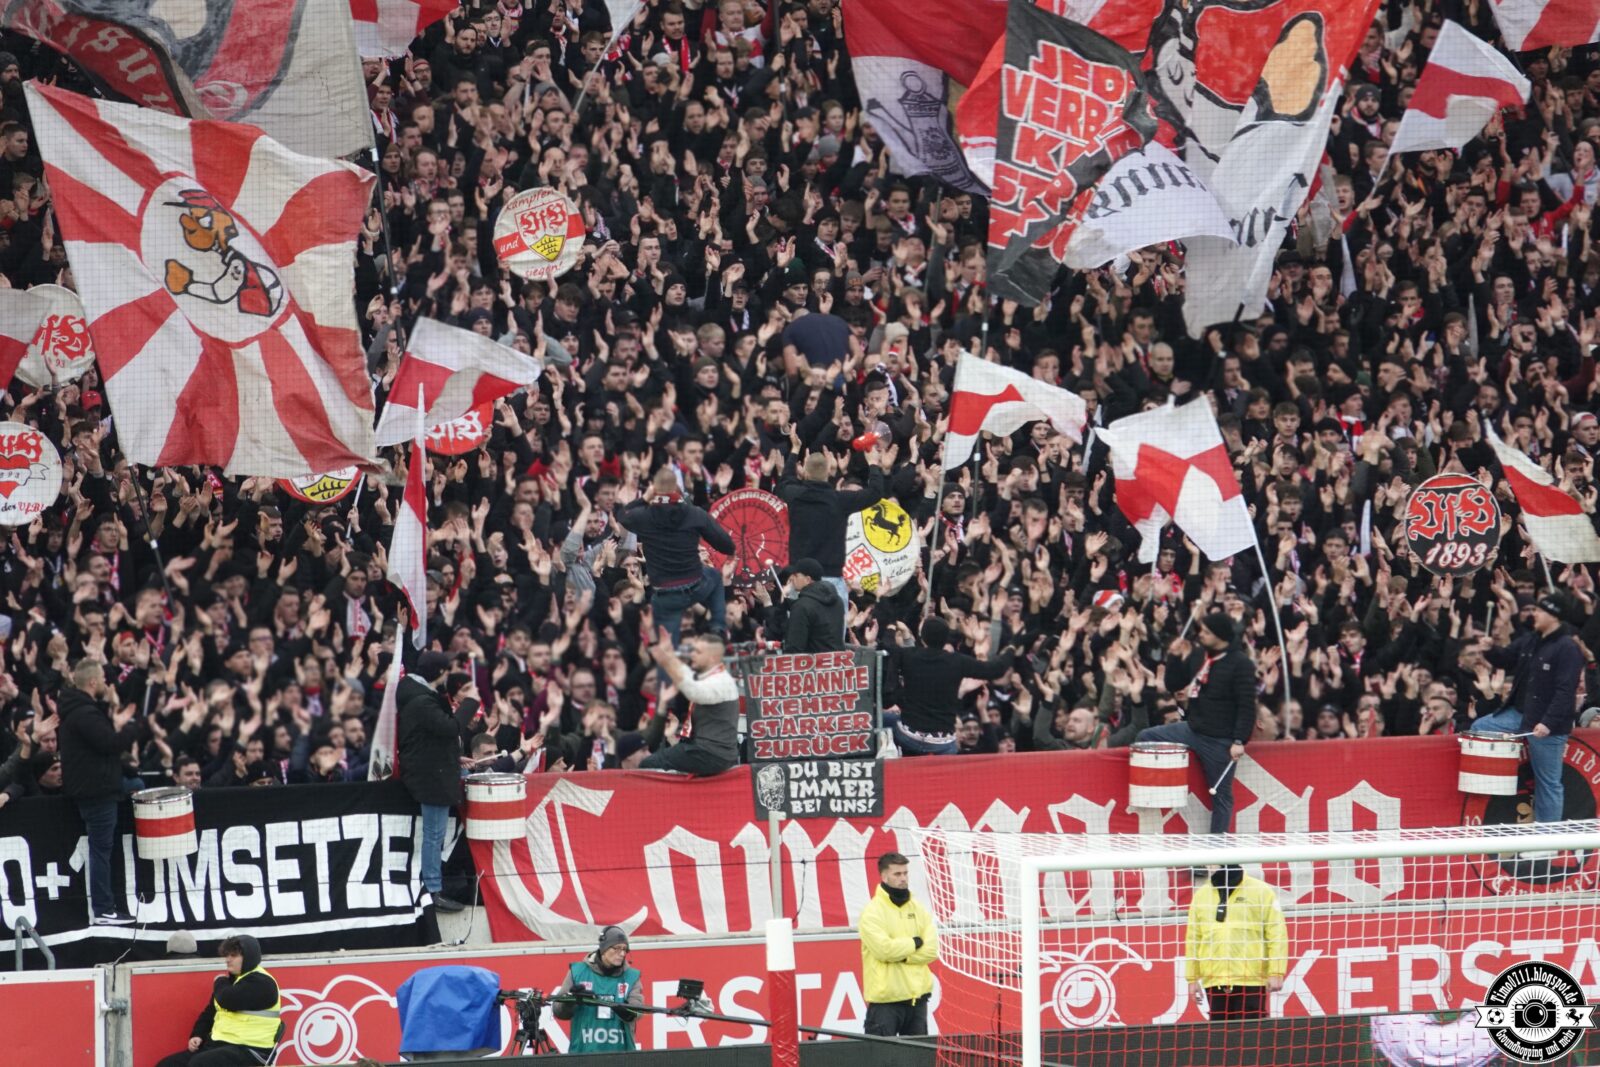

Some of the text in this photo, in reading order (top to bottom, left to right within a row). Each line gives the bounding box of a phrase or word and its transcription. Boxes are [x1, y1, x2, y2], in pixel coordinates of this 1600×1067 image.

[520, 203, 567, 236] VfB
[499, 235, 519, 253] und
[1407, 486, 1496, 541] VfB
[1425, 541, 1488, 568] 1893
[760, 650, 856, 674] JEDER
[748, 666, 870, 698] VERBANNTE
[761, 692, 860, 718] KEHRT
[754, 732, 871, 759] ZURÜCK
[788, 761, 876, 778] DU BIST
[789, 778, 876, 799] IMMER
[790, 798, 878, 814] BEI UNS!
[581, 1027, 626, 1045] HOST
